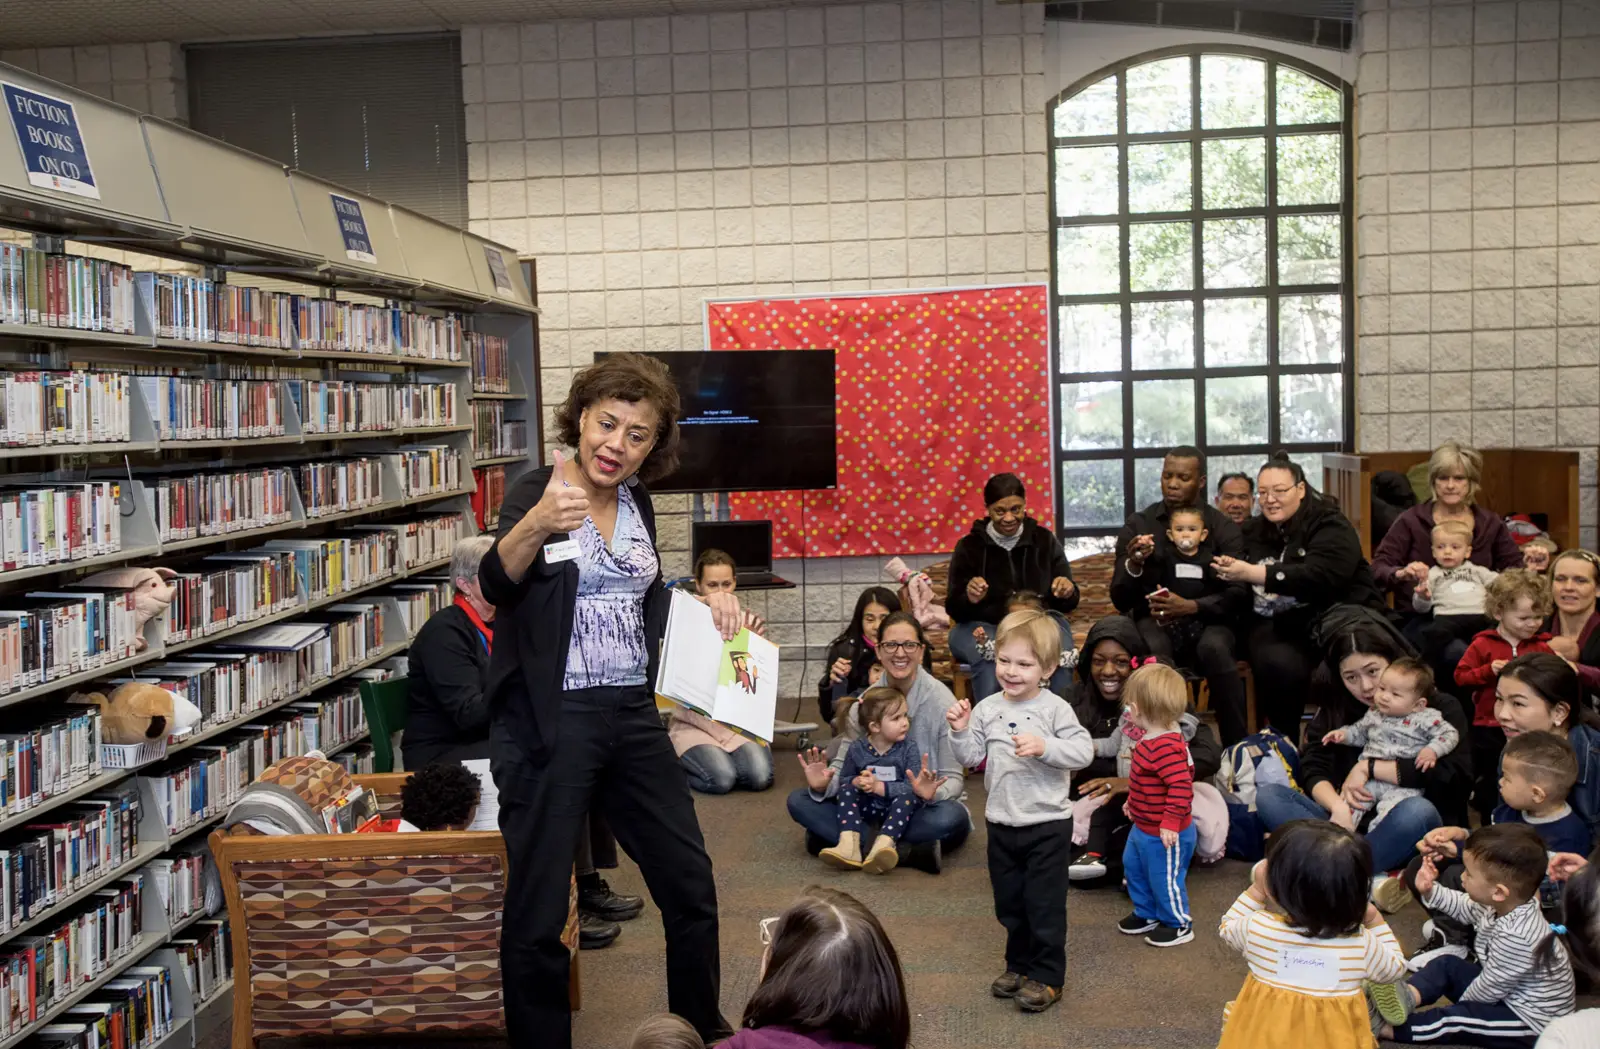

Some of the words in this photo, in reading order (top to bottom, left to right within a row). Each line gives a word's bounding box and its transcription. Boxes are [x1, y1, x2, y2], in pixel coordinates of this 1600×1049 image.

[14, 95, 70, 126] FICTION
[26, 125, 75, 153] BOOKS
[39, 155, 60, 175] ON
[61, 160, 80, 179] CD
